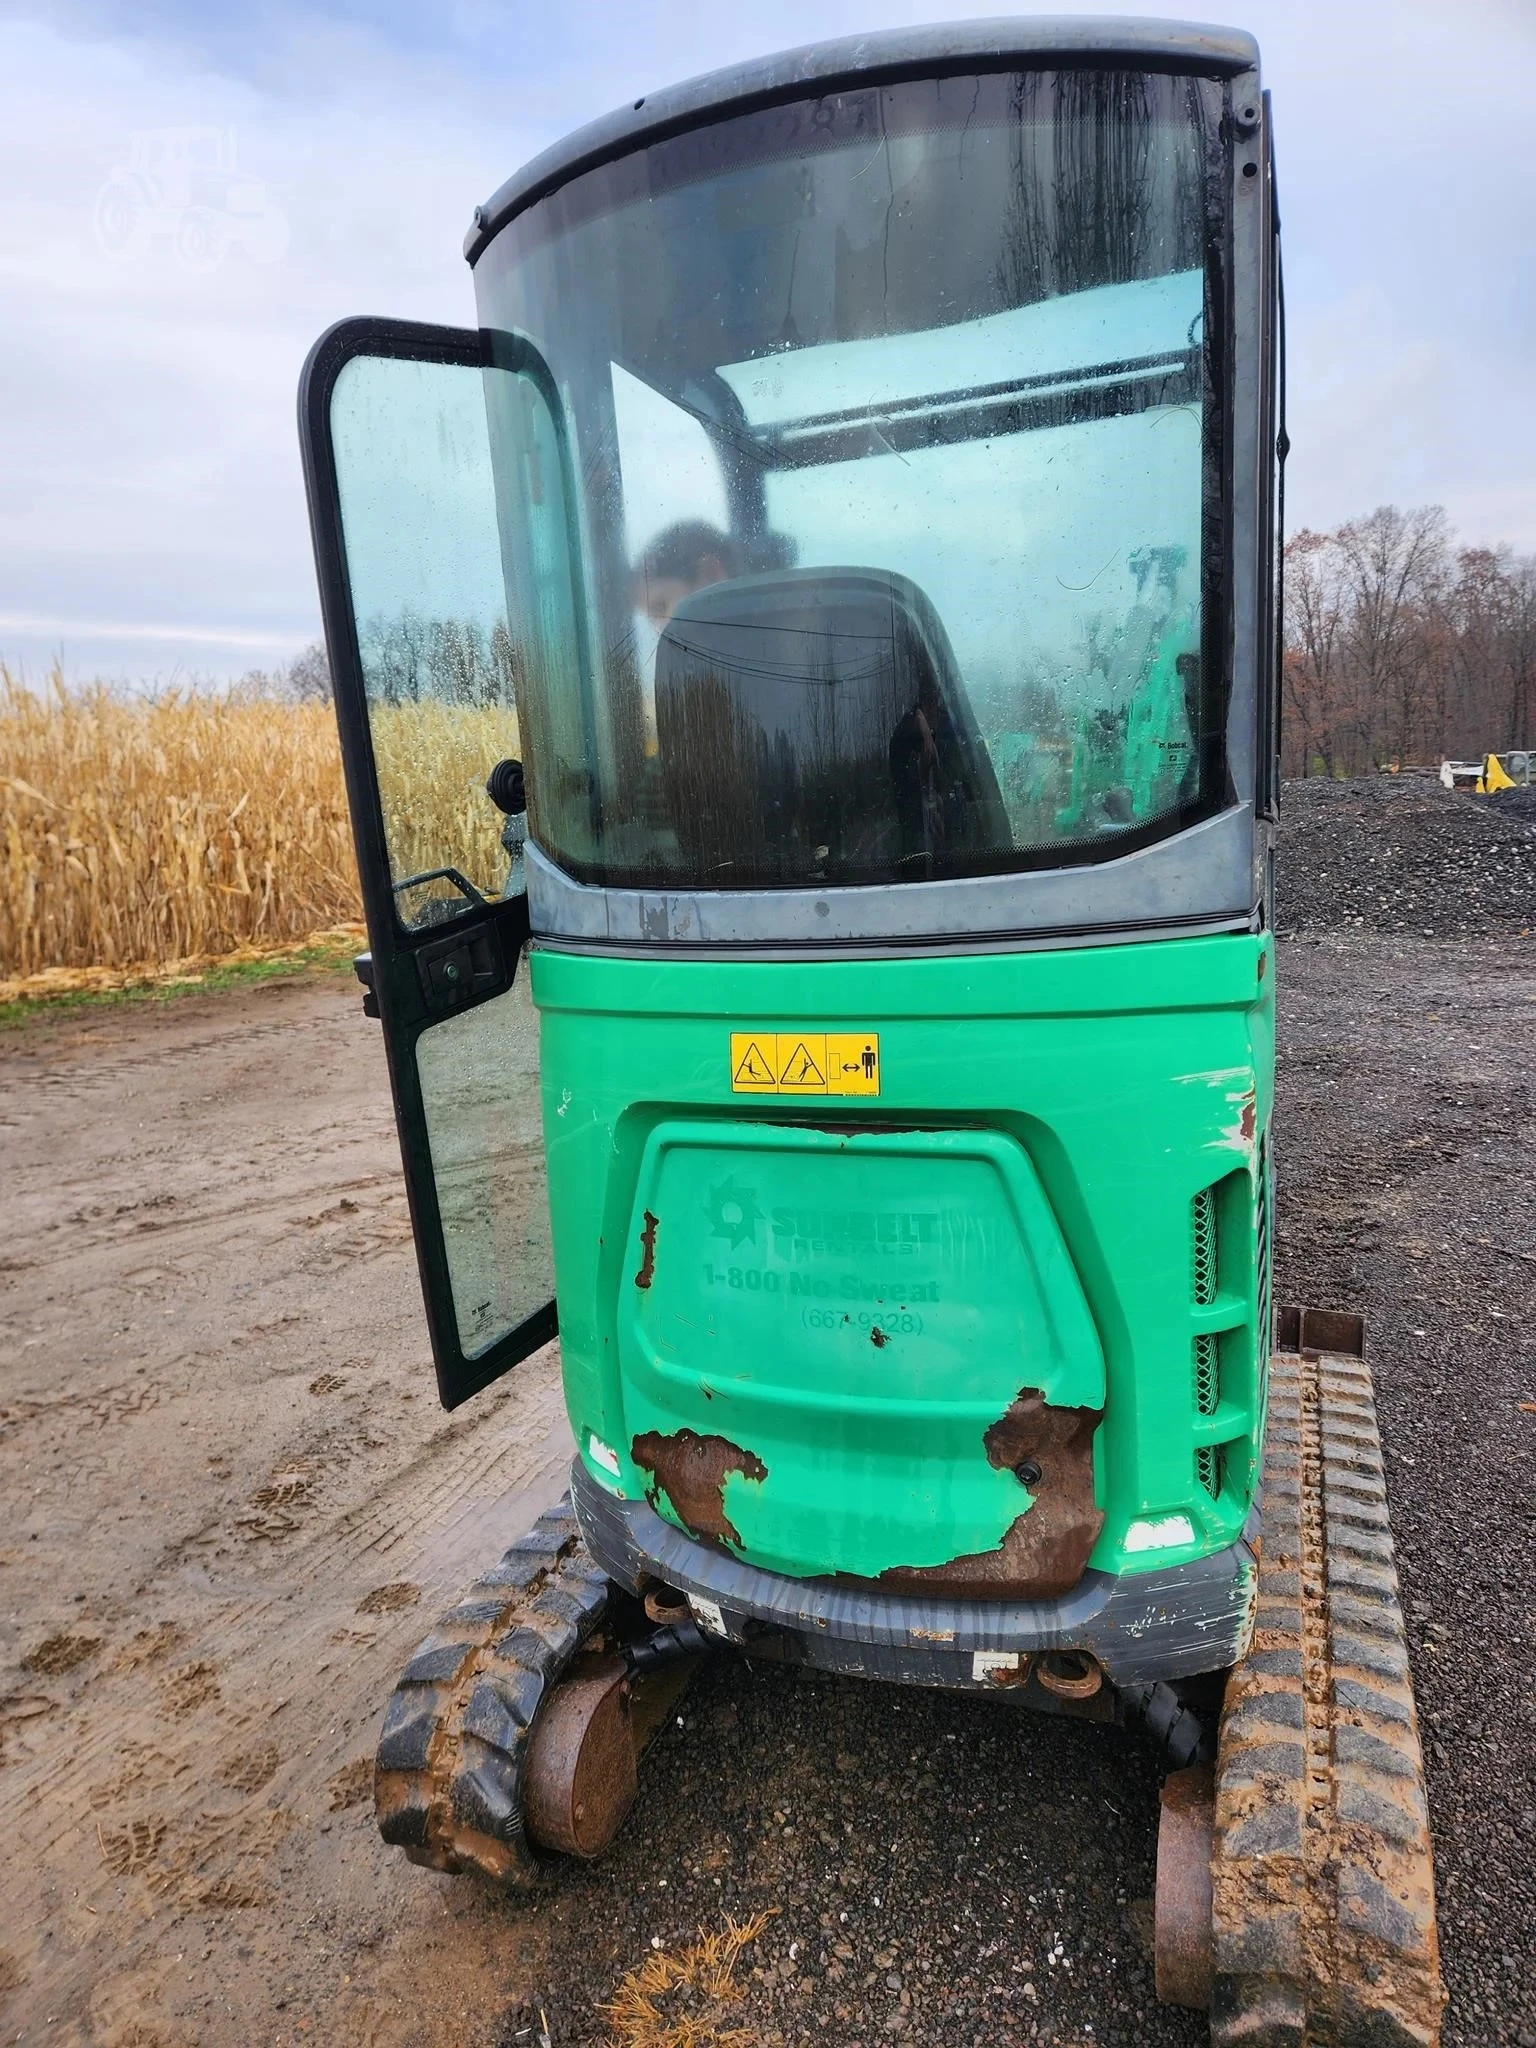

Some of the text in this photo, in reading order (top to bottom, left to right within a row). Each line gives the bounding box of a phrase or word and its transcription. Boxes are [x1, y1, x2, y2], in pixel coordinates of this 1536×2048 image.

[794, 1238, 914, 1255] RENTALS
[703, 1263, 940, 1303] 1-800 No Sweat
[801, 1305, 925, 1337] (667-9328)
